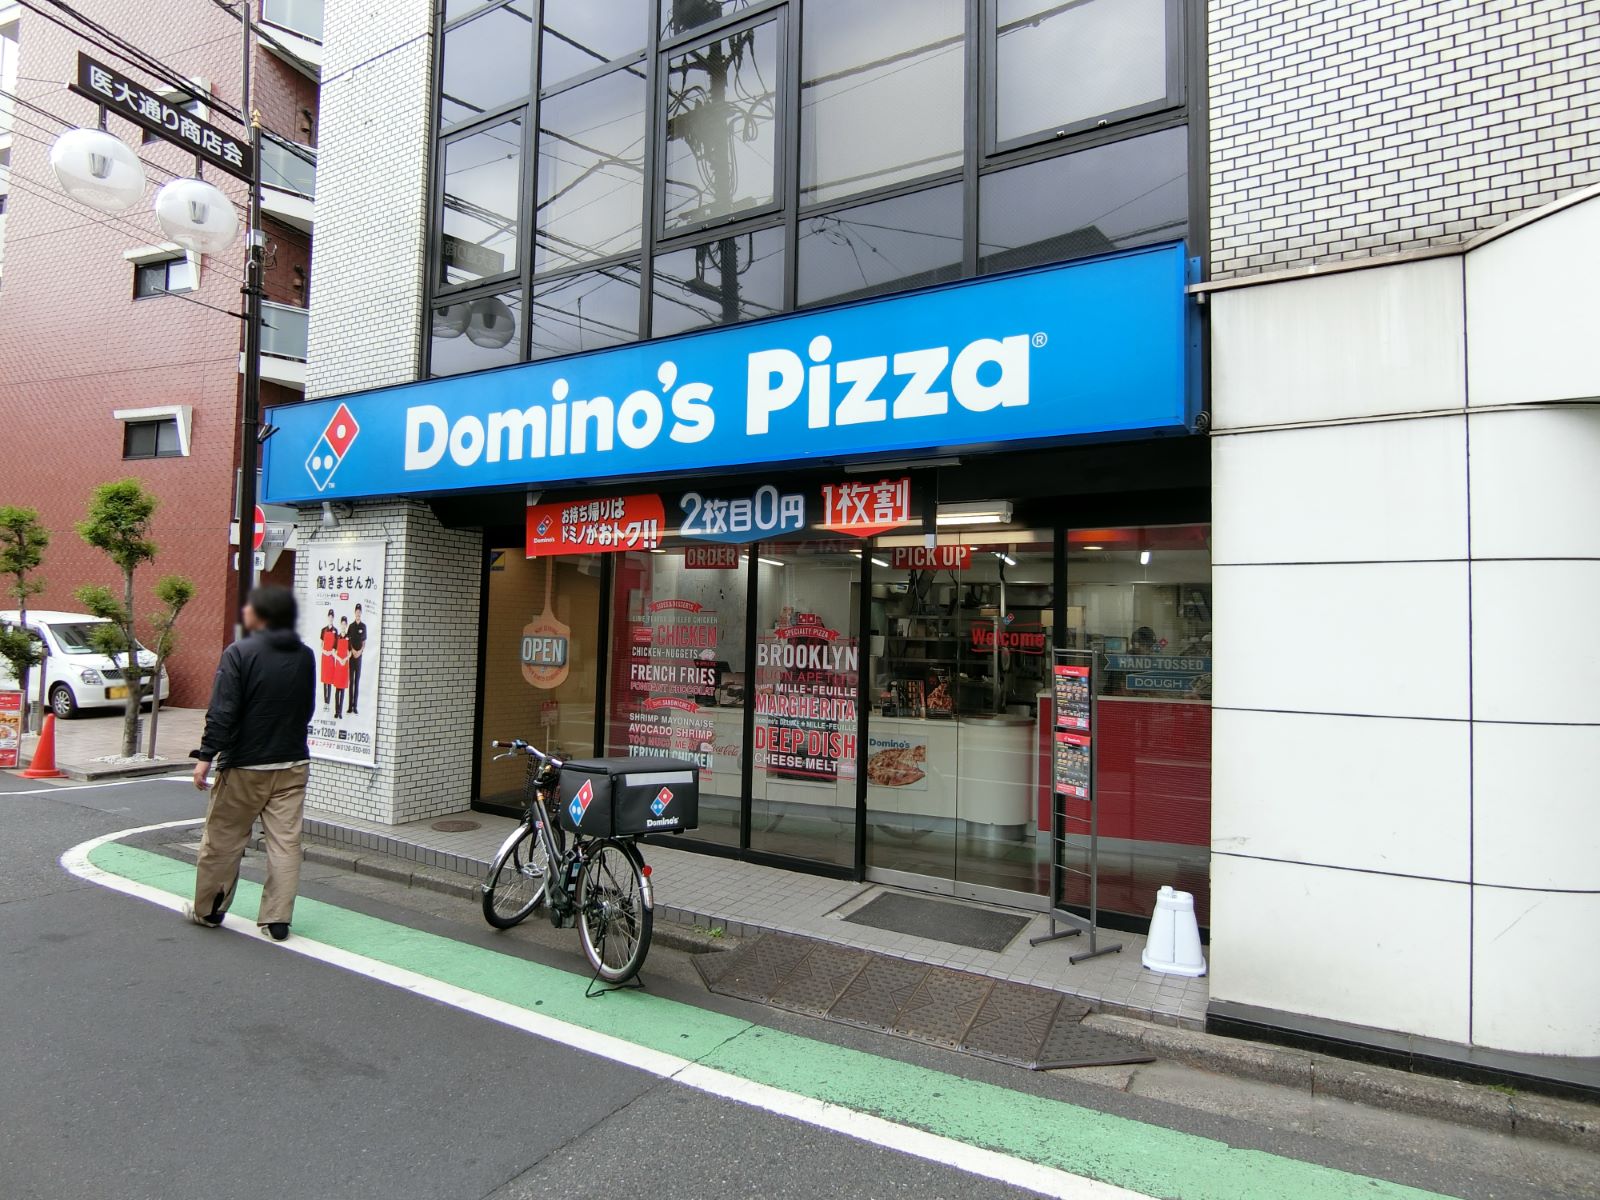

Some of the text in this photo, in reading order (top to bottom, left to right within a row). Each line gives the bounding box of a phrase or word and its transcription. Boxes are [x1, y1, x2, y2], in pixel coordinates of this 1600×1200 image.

[90, 65, 243, 168] 医大通り商店会
[404, 360, 716, 472] Domino's
[746, 334, 1030, 436] Pizza
[561, 497, 625, 524] お持ち帰りは
[679, 479, 909, 536] 2枚目0円 1枚割
[561, 519, 658, 549] ドミノがおトク!!
[318, 558, 362, 572] いっしょに
[687, 548, 736, 566] ORDER
[895, 546, 967, 567] PICK UP
[316, 575, 378, 590] 働きませんか。
[692, 616, 718, 624] CHICKEN
[657, 625, 718, 648] CHICKEN
[812, 628, 829, 639] PIZZA
[972, 627, 1045, 648] Welcome
[522, 637, 563, 663] OPEN
[631, 646, 699, 660] CHICKEN-NUGGETS
[756, 643, 859, 671] BROOKLYN
[1119, 657, 1204, 670] HAND-TOSSED
[631, 664, 716, 685] FRENCH FRIES
[1134, 677, 1183, 689] DOUGH
[775, 683, 857, 697] MILLE-FEUILLE
[755, 693, 856, 722] MARGHERITA
[629, 713, 714, 728] SHRIMP MAYONNAISE
[806, 721, 857, 732] MILLE-FEUILLE
[628, 723, 713, 740] AVOCADO SHRIMP
[629, 734, 646, 745] TOO
[755, 725, 857, 760] DEEP DISH
[869, 738, 911, 749] Domino's
[754, 752, 803, 768] CHEESE
[805, 758, 839, 772] MELT
[646, 816, 679, 827] Domino's
